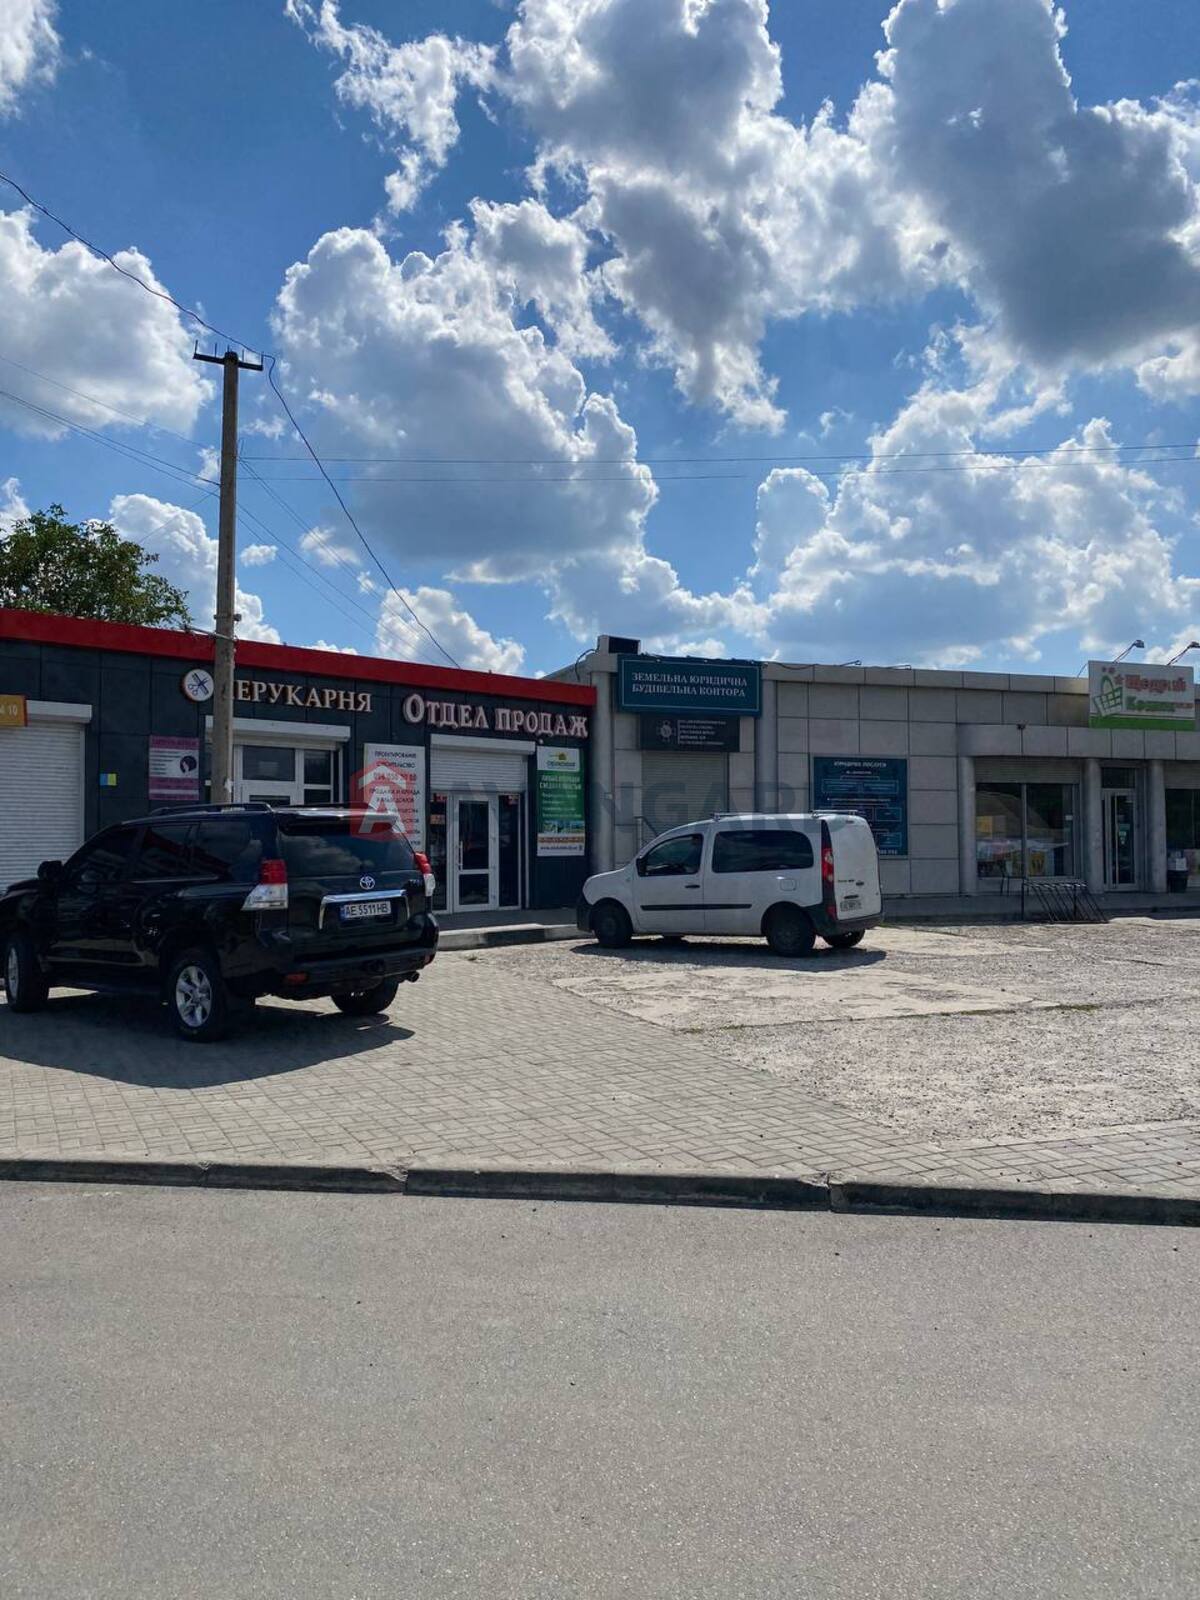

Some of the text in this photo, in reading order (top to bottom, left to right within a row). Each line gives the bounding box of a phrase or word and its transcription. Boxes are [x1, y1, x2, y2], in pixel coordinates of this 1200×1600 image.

[632, 672, 747, 687] ЗЕМЕЛЬНА ЮРИДИЧНА
[231, 679, 373, 712] ЕРУКАРНЯ
[632, 683, 745, 697] БУДІВЕЛЬНА КОНТОРА
[495, 708, 588, 738] ПРОДАЖ
[345, 905, 357, 916] AE
[359, 903, 376, 914] 5511
